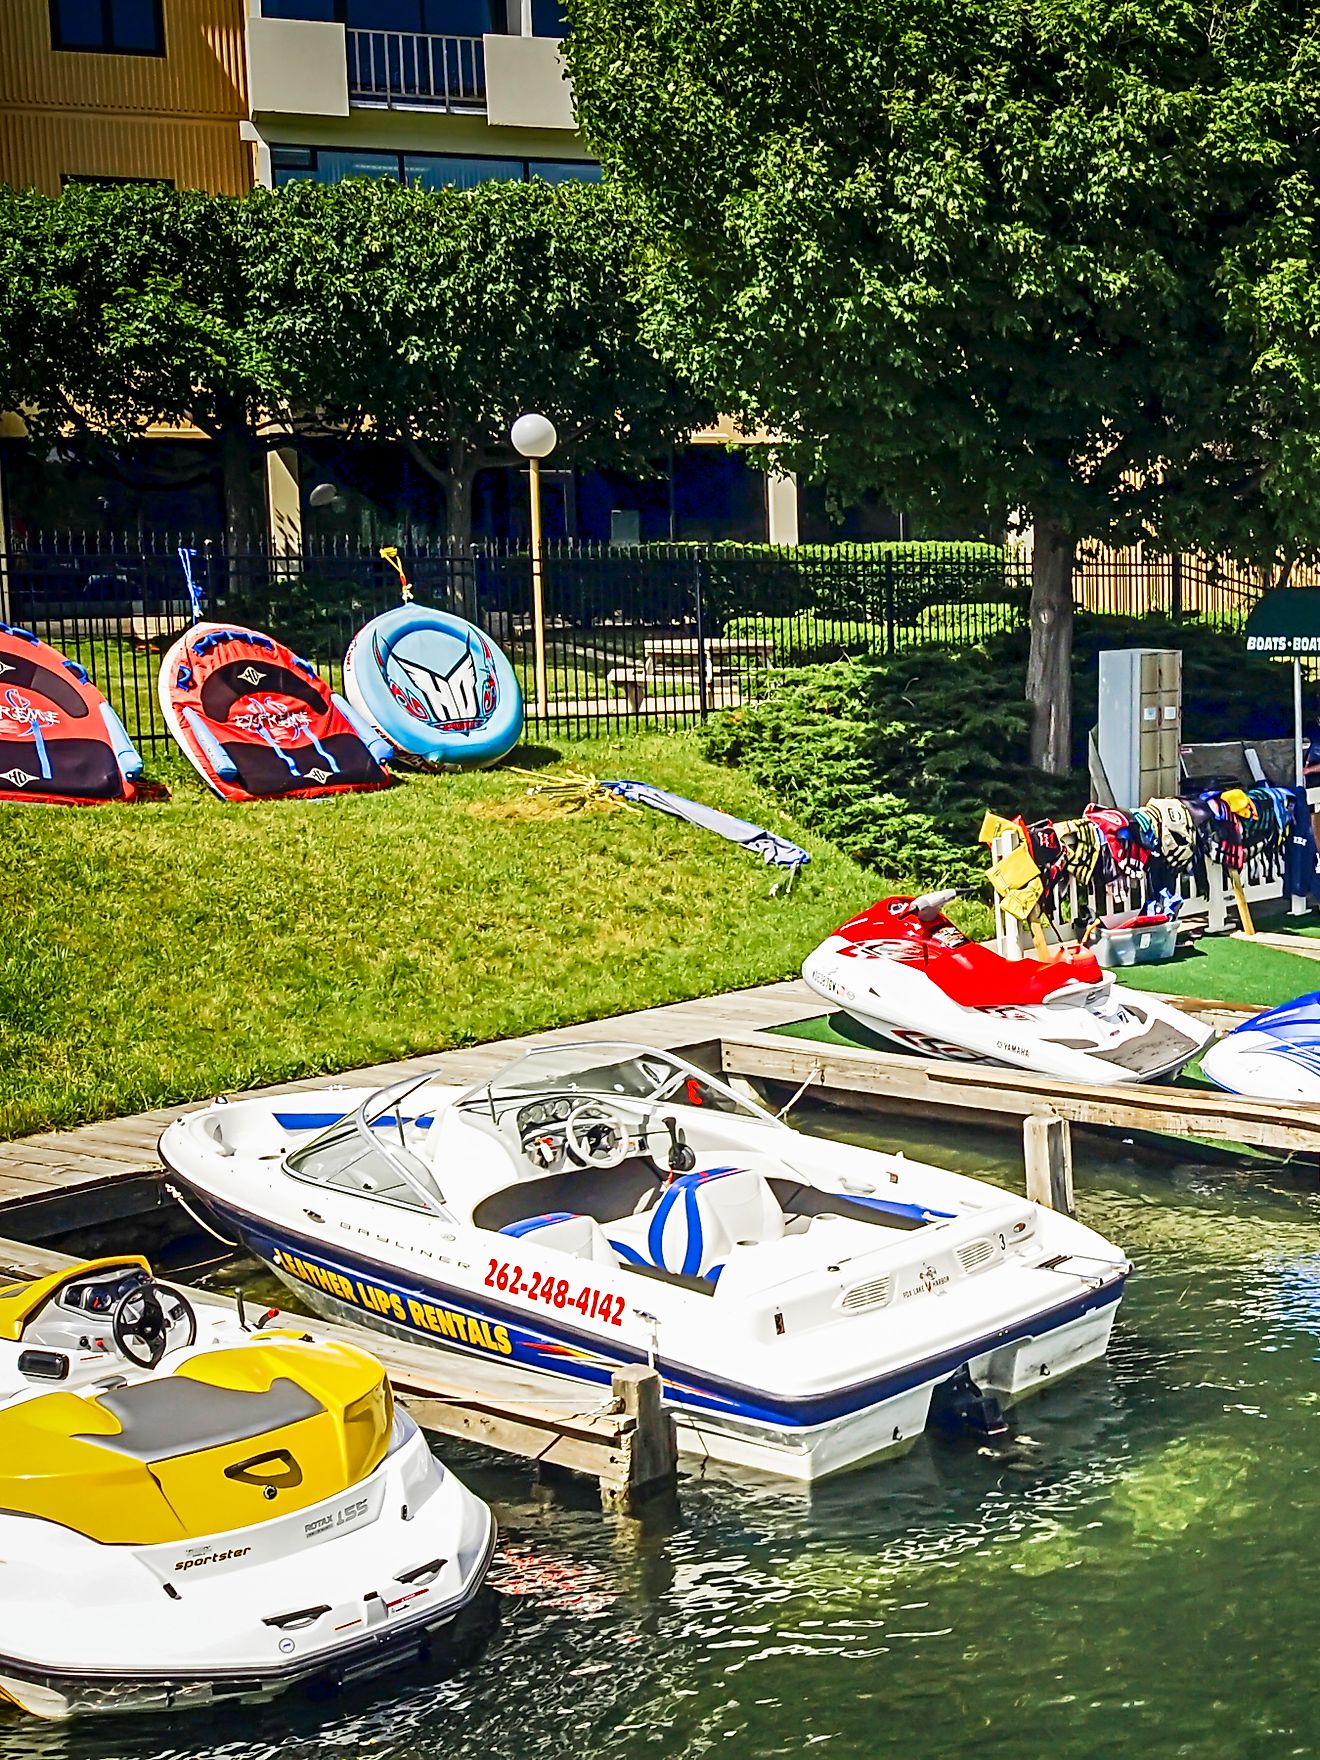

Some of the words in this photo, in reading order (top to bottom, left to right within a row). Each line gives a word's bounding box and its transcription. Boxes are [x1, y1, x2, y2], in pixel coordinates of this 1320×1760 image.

[1003, 1043, 1030, 1058] YAMAHA
[339, 1221, 471, 1271] BAYLINER
[998, 1233, 1006, 1251] 3
[273, 1248, 358, 1304] LEATHER
[356, 1279, 407, 1322] LIPS
[409, 1296, 513, 1356] RENTALS
[484, 1257, 626, 1327] 262-248-4142
[304, 1514, 333, 1534] ROTAX
[174, 1546, 252, 1571] sportster
